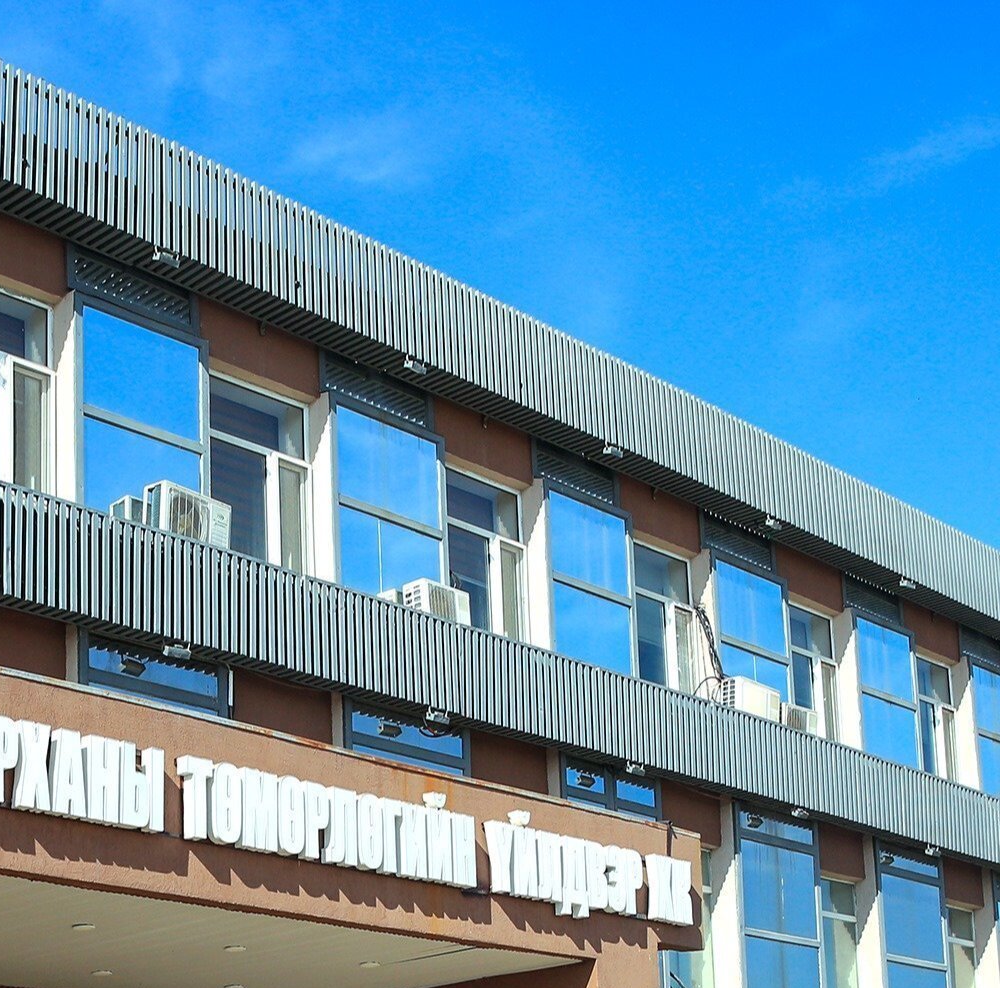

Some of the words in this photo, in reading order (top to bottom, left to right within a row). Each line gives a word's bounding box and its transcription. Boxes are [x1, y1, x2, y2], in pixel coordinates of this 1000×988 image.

[176, 754, 477, 889] ТӨМӨРЛӨГИЙН
[483, 809, 643, 919] ҮЙЛДВЭР
[645, 853, 693, 926] ХК
